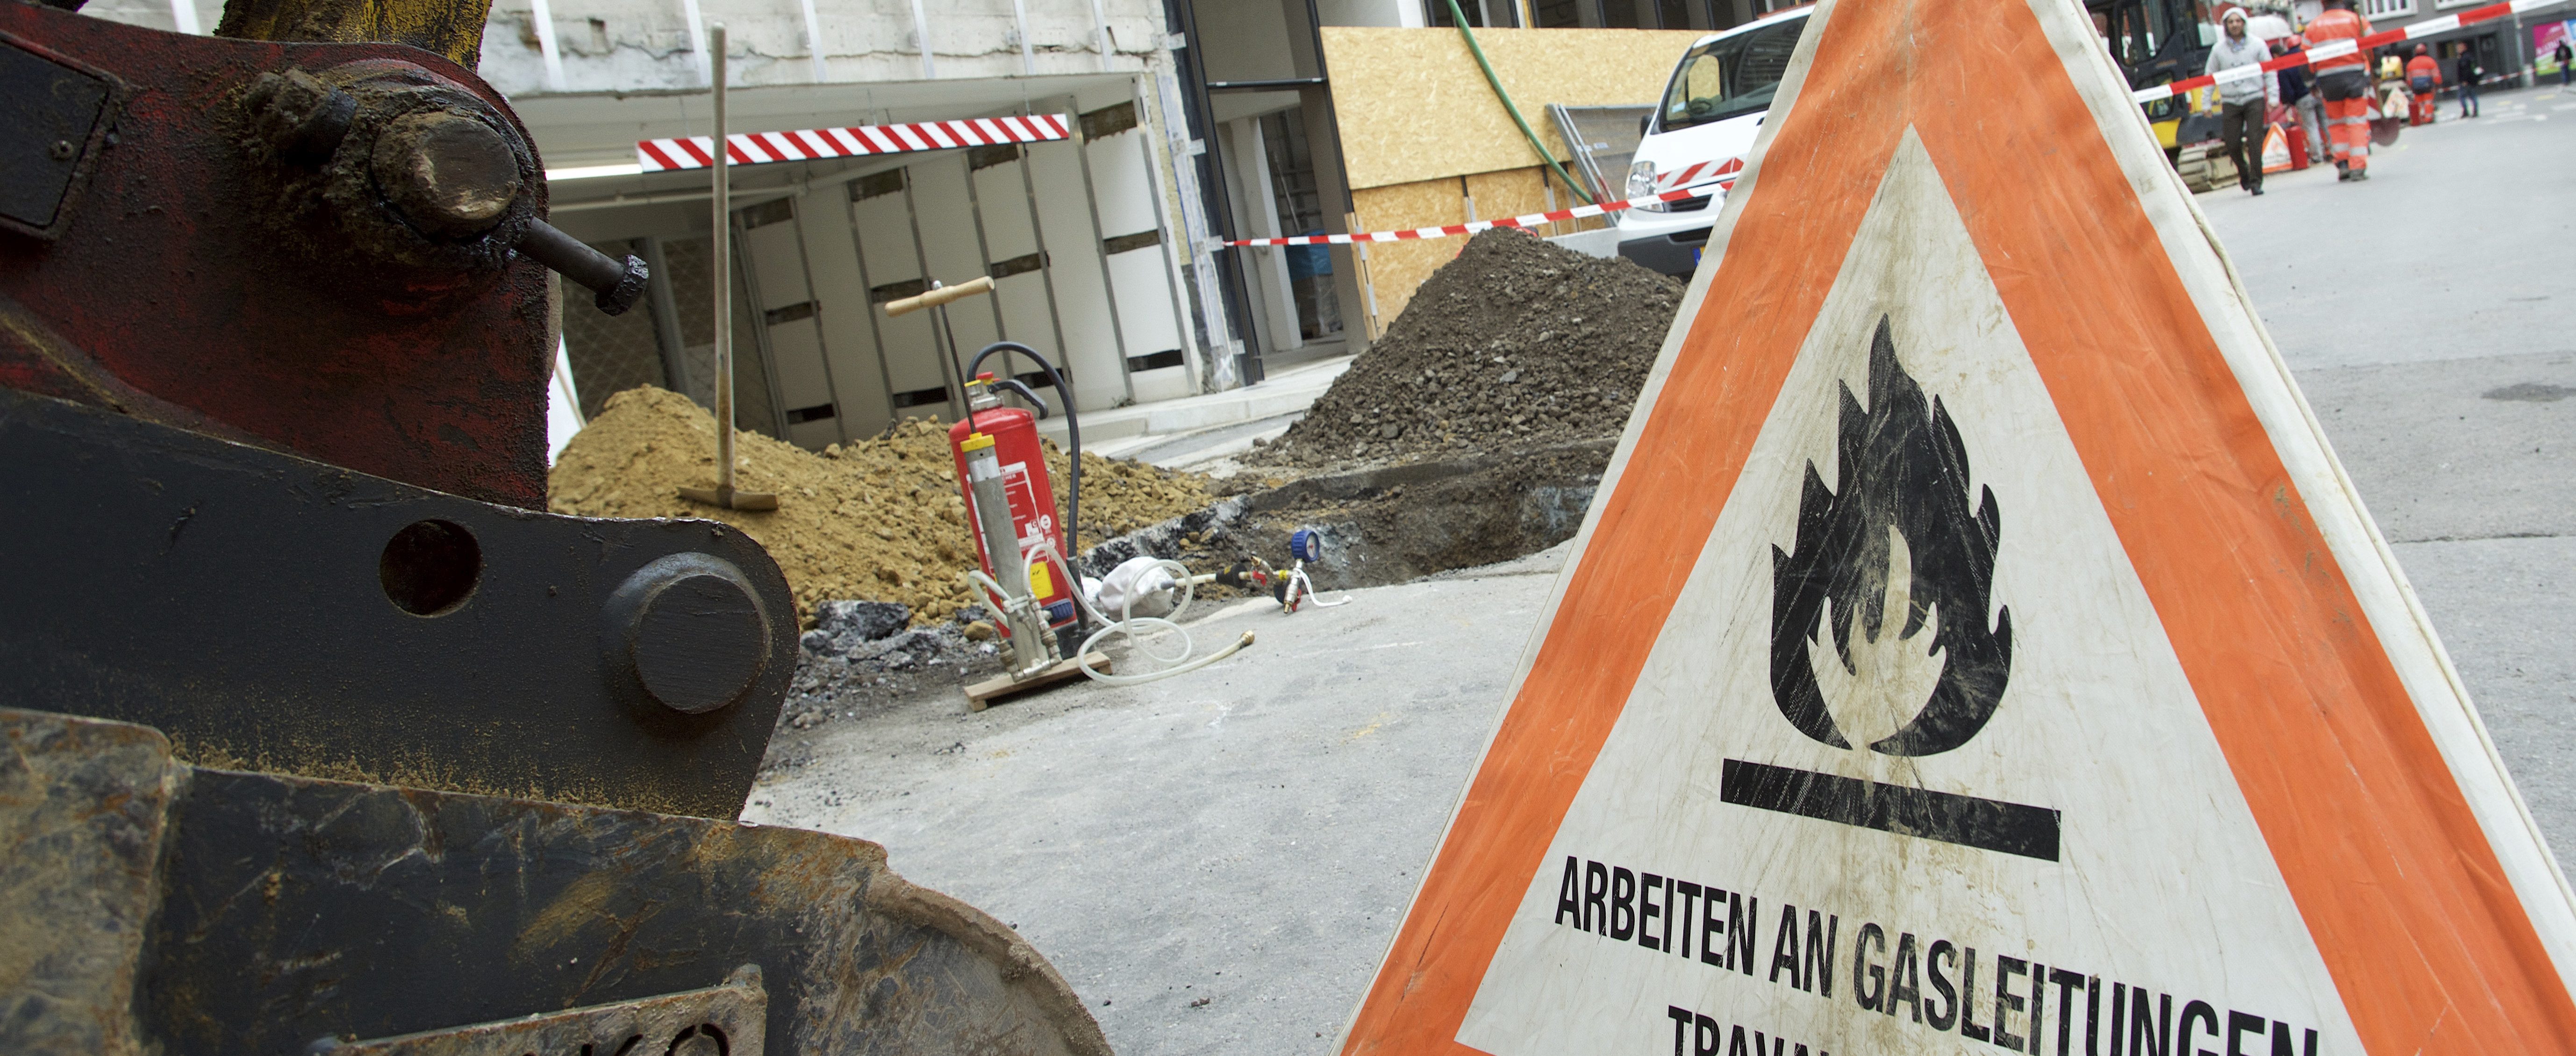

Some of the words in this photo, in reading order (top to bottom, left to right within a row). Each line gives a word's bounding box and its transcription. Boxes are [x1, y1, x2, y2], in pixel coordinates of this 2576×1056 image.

[1555, 855, 1757, 976] ARBEITEN
[1769, 904, 1838, 999] AN
[1853, 922, 2318, 1056] GASLEITUNG
